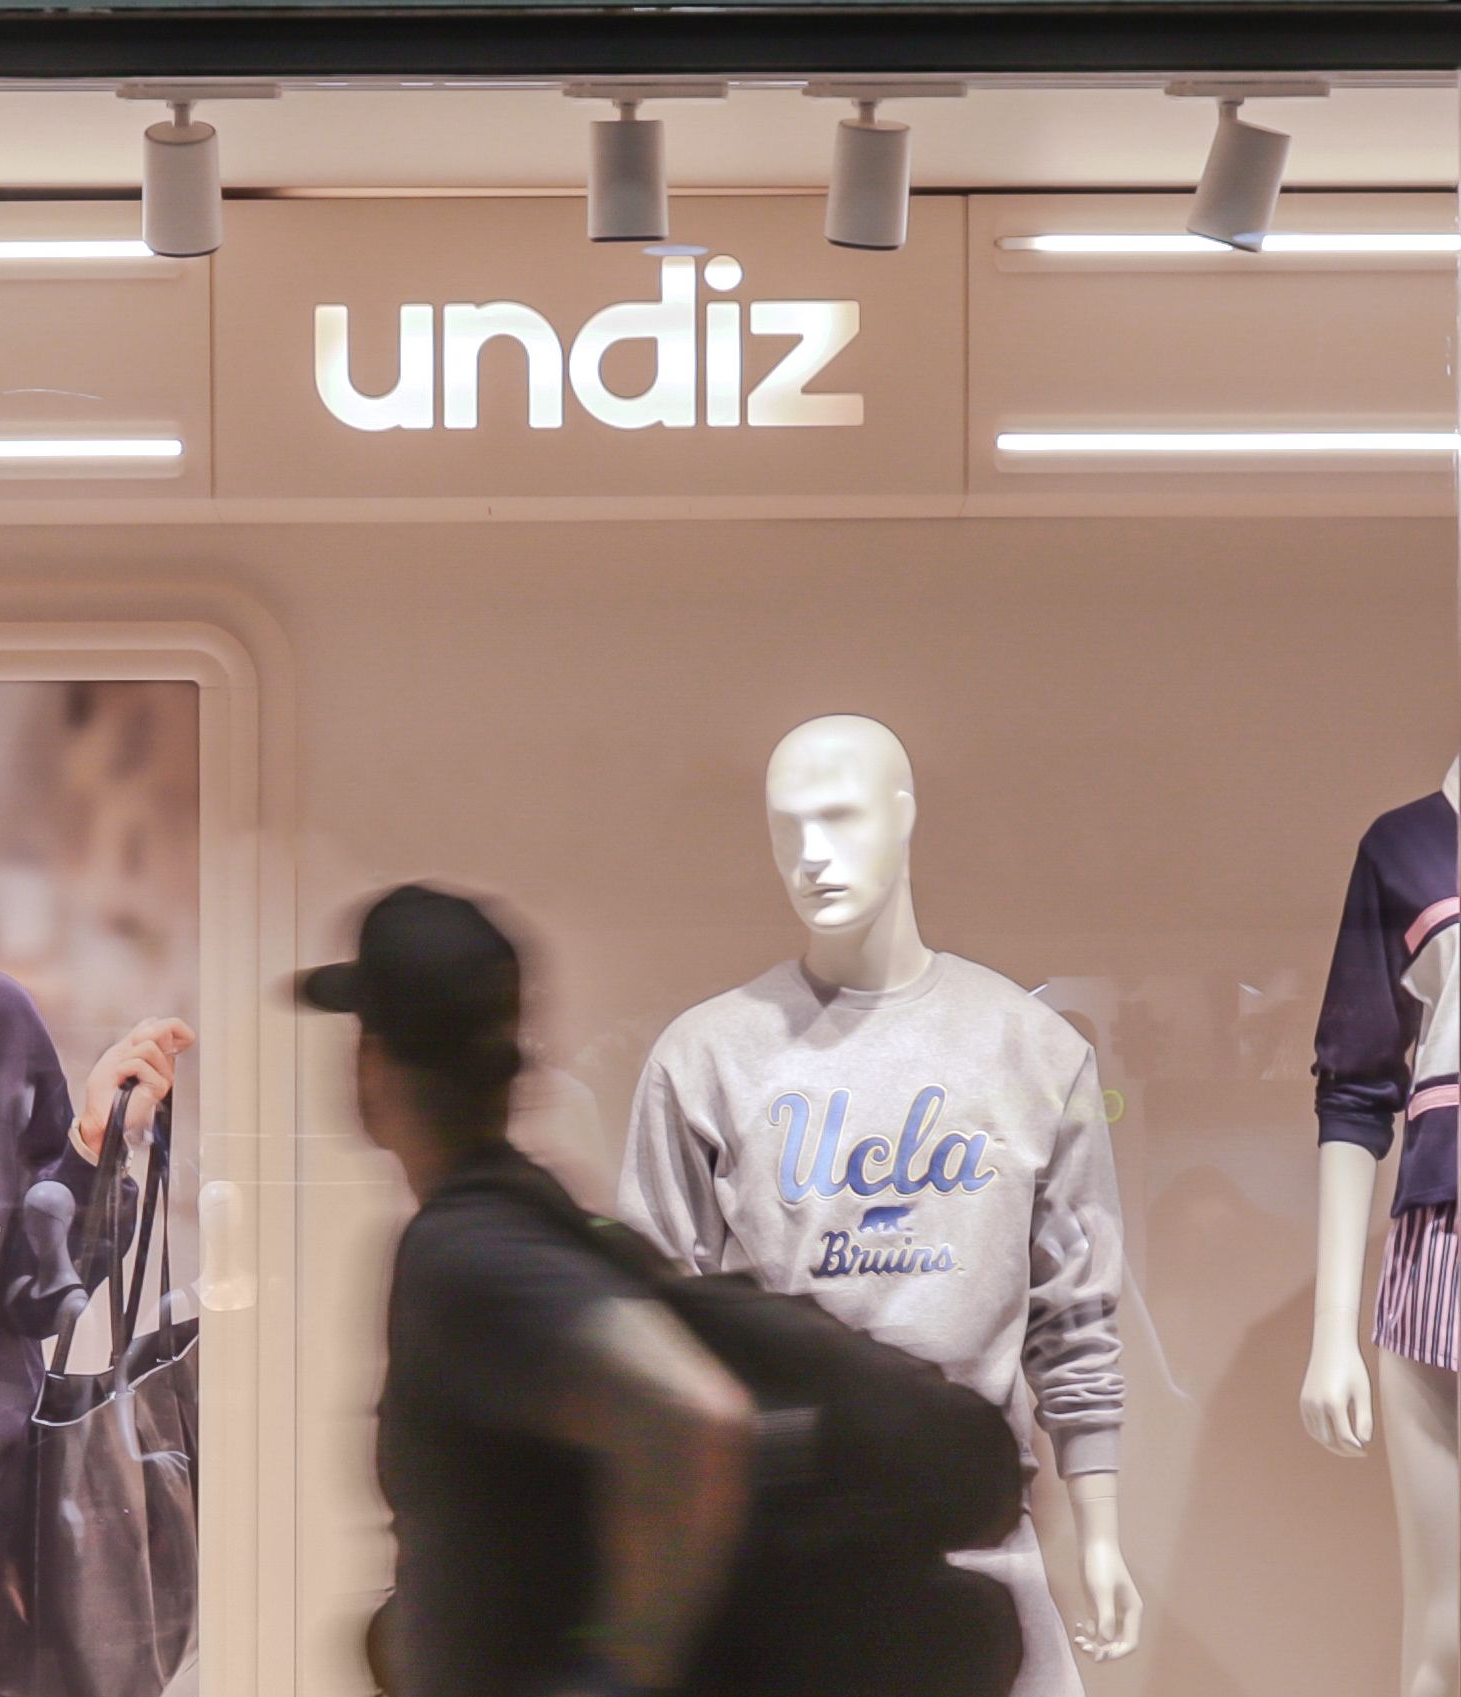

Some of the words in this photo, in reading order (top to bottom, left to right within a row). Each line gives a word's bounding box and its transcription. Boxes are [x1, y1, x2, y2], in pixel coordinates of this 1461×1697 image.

[315, 254, 864, 431] undiz
[768, 1084, 998, 1205] Ucla
[811, 1230, 957, 1278] Bruins
